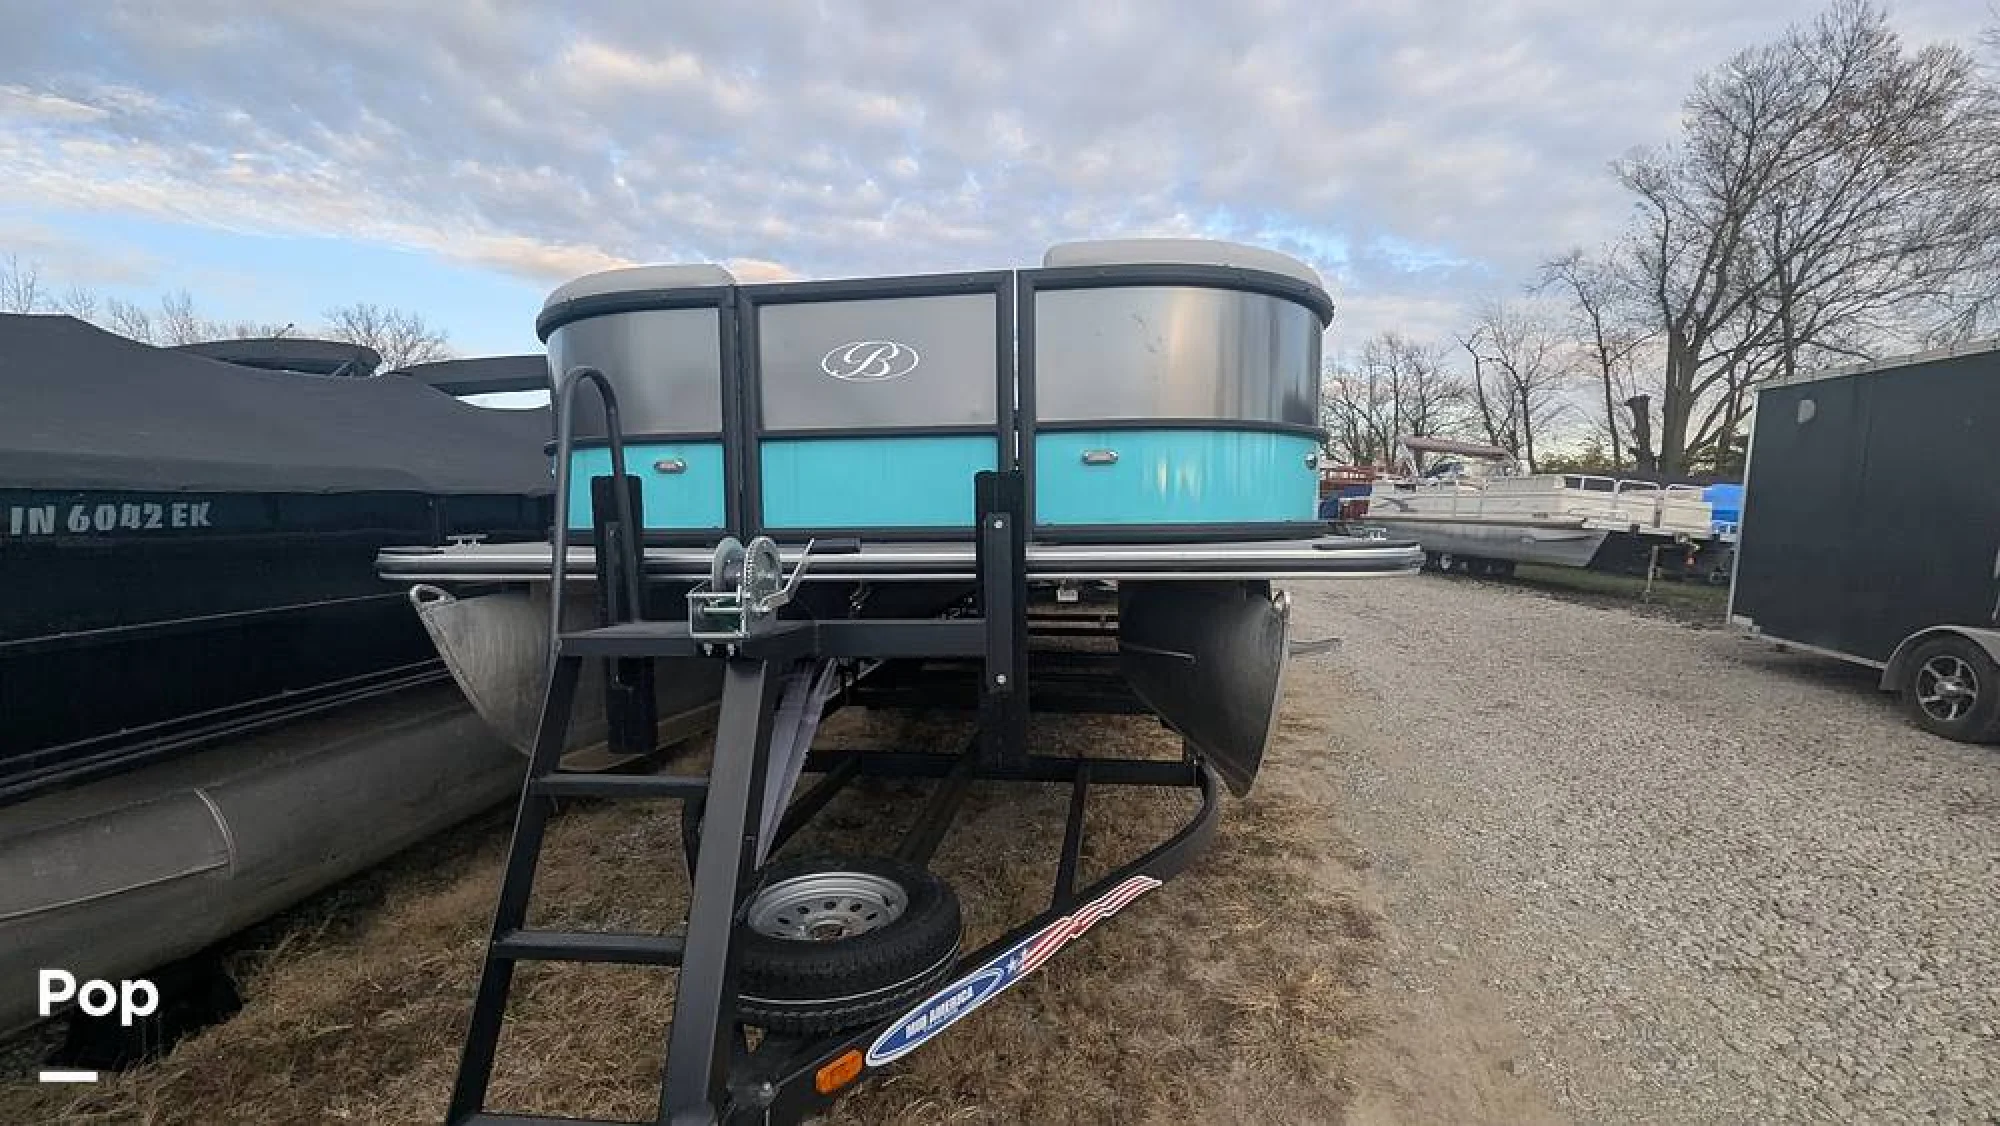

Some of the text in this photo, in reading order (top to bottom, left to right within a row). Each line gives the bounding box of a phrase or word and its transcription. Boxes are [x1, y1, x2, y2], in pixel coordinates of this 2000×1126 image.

[843, 341, 899, 377] B
[10, 501, 212, 535] IN 6042 EK
